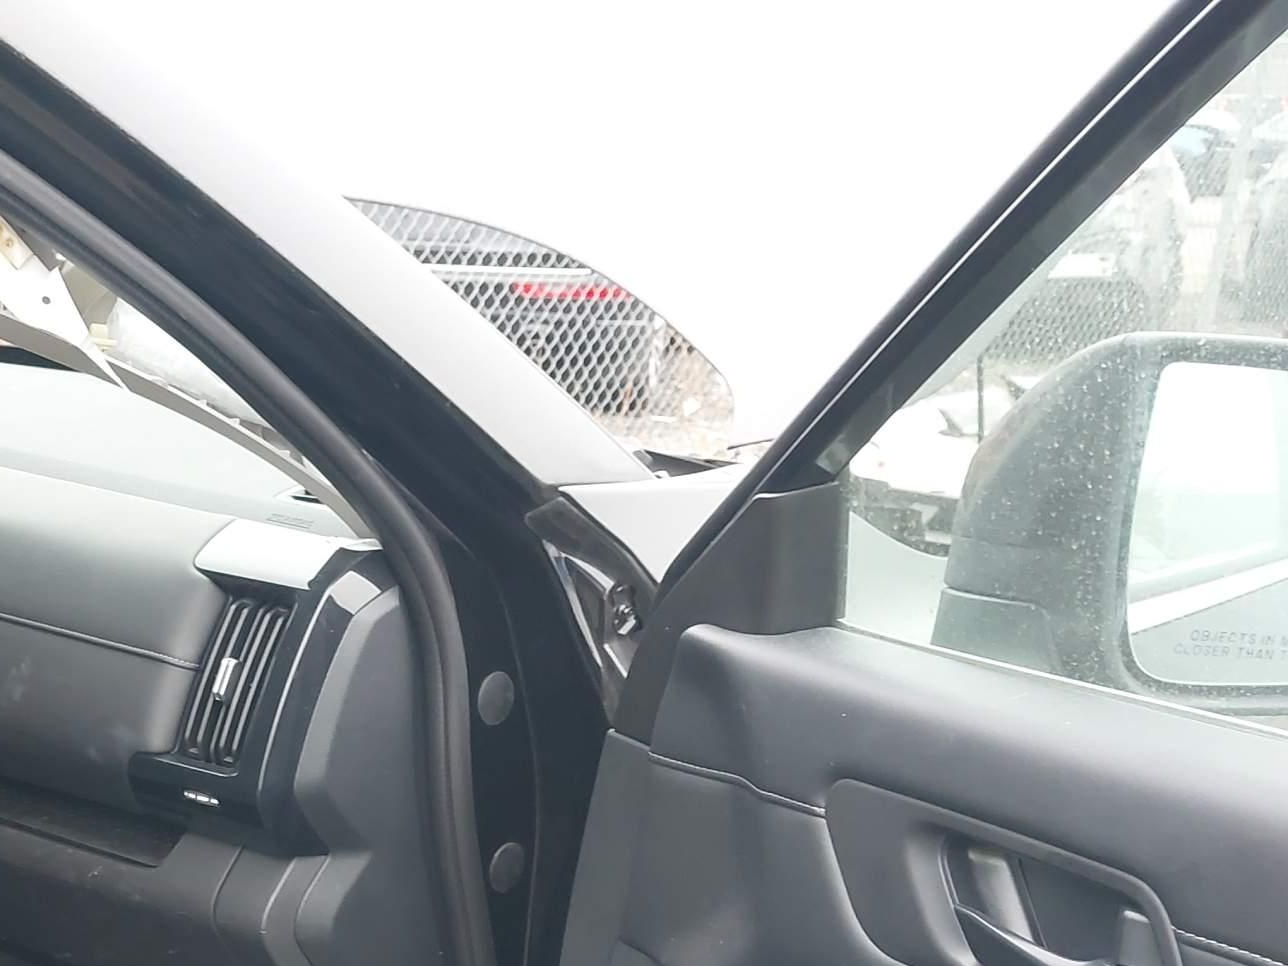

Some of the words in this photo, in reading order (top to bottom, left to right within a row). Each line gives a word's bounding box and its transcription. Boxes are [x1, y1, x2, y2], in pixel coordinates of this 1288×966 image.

[1191, 630, 1257, 645] OBJECTS
[1261, 633, 1276, 646] IN
[1173, 643, 1230, 657] CLOSER
[1238, 647, 1274, 660] THAN
